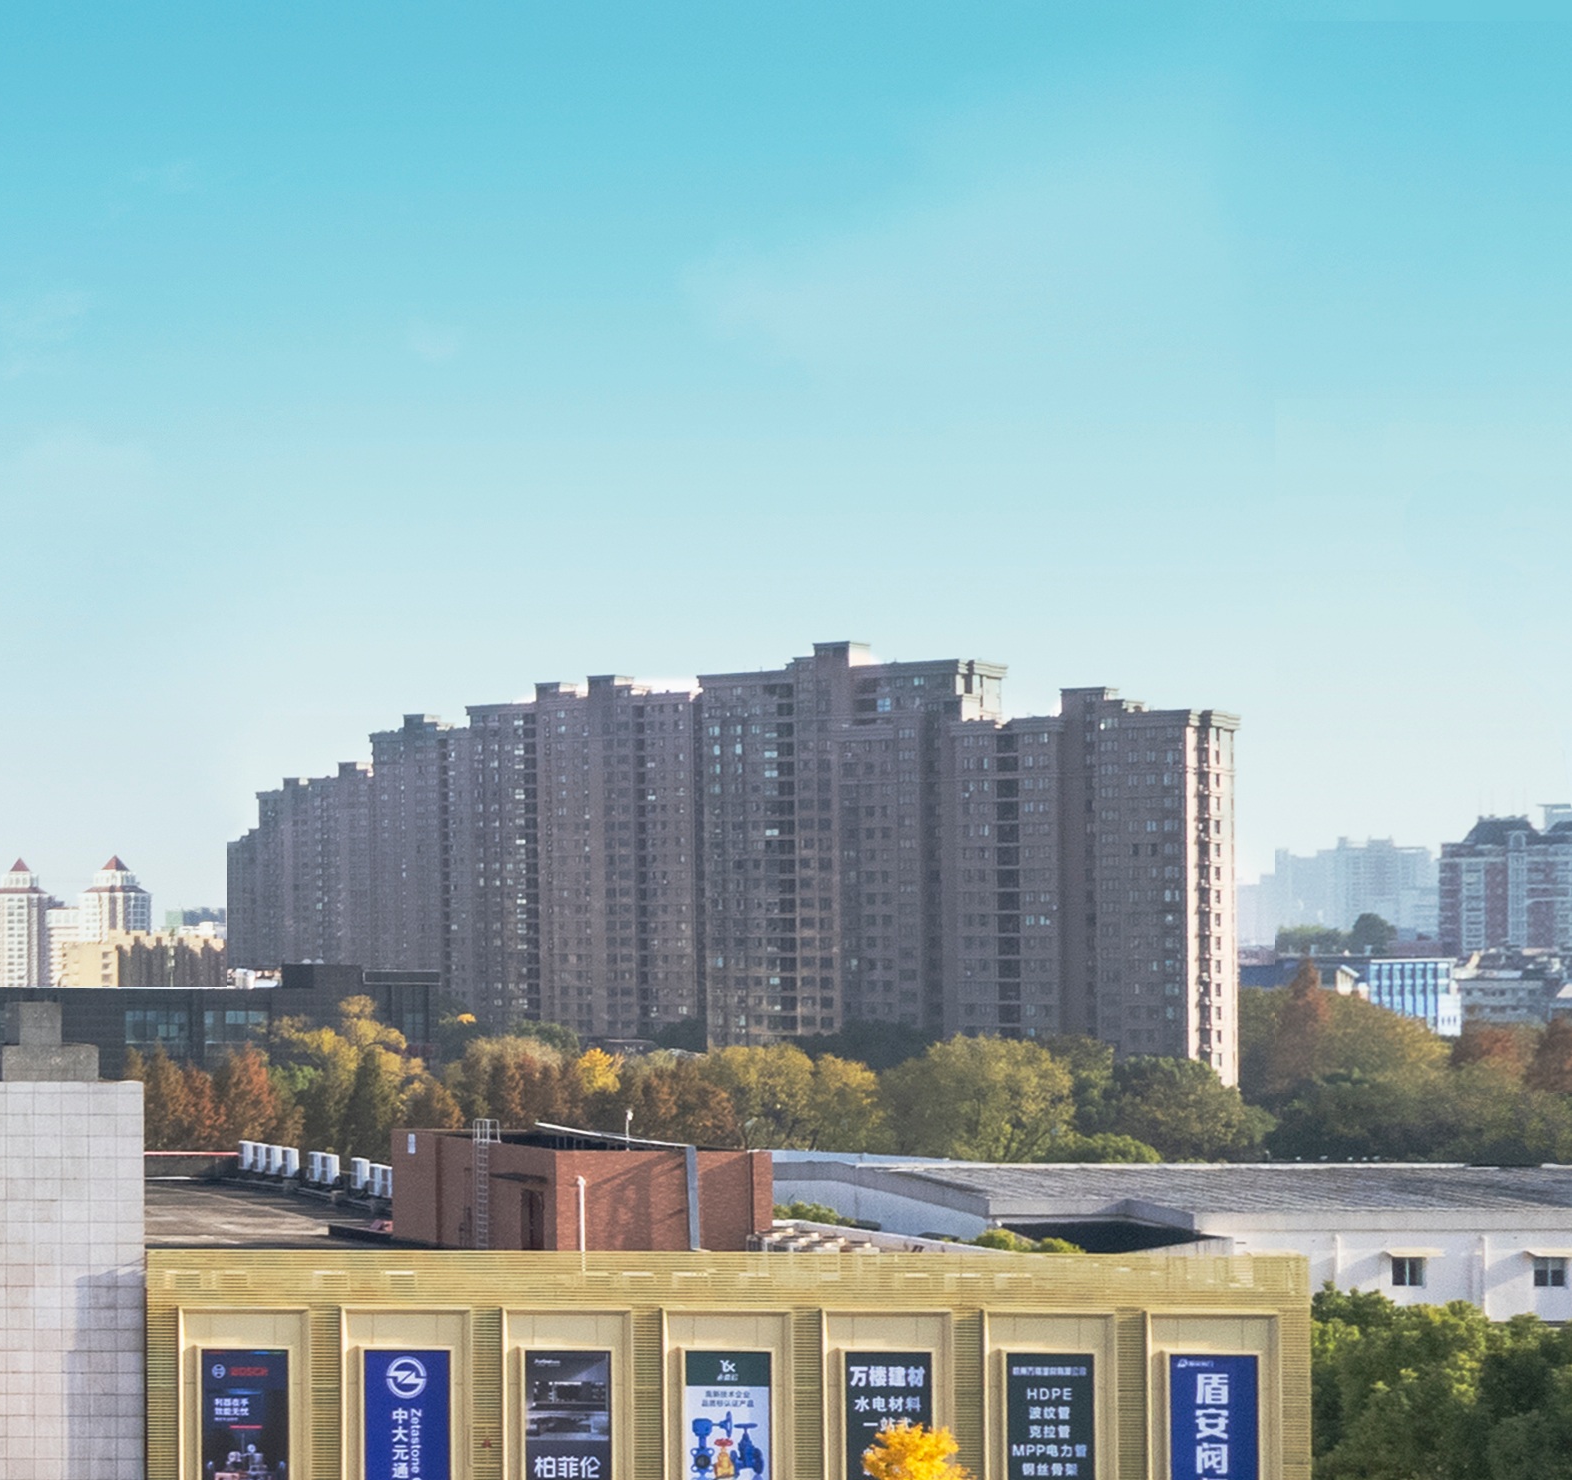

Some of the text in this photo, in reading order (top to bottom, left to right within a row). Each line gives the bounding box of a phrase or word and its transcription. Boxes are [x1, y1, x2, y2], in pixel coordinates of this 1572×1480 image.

[1027, 1387, 1073, 1401] HDPE
[854, 1396, 922, 1413] 水电材料
[1029, 1406, 1071, 1420] 波纹管
[1029, 1425, 1071, 1439] 克拉管
[411, 1408, 423, 1475] Zetastone
[1011, 1444, 1088, 1458] MPP电力管
[534, 1456, 601, 1478] 柏菲伦
[1022, 1463, 1079, 1477] 钢丝骨架
